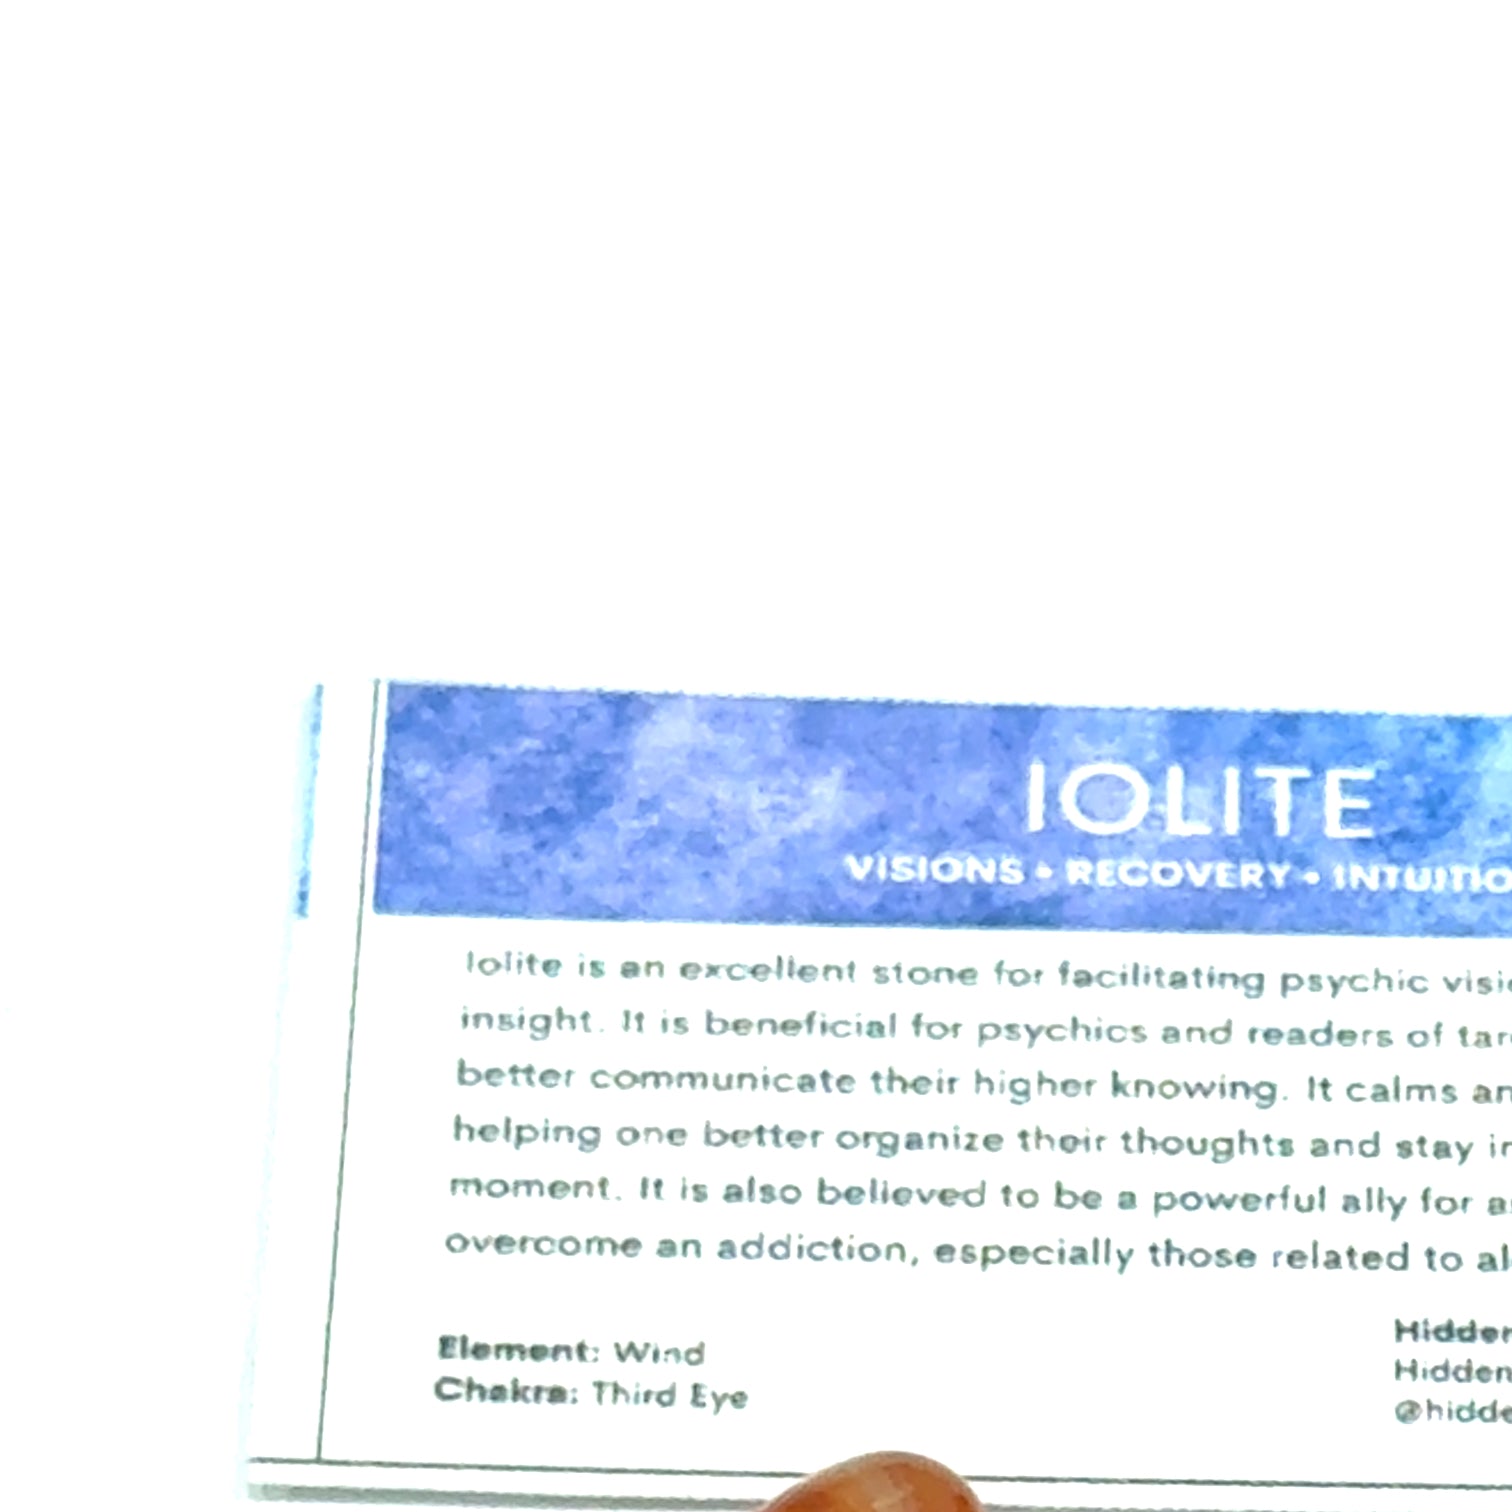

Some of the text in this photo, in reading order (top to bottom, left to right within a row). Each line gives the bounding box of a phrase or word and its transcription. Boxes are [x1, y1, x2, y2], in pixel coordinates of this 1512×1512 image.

[1027, 762, 1377, 839] IOLITE
[844, 853, 1025, 886] VISIONS
[1066, 857, 1290, 890] RECOVERY
[466, 950, 563, 978] Iolite
[578, 952, 606, 979] is
[619, 960, 665, 979] an
[679, 954, 856, 984] excellent
[872, 962, 979, 986] stone
[993, 959, 1044, 988] for
[1058, 959, 1265, 1000] facilitating
[1280, 967, 1429, 999] psychic
[622, 1009, 645, 1033] It
[660, 1009, 689, 1035] is
[705, 1009, 897, 1039] beneficial
[911, 1012, 963, 1041] for
[977, 1015, 1148, 1049] psychics
[1161, 1018, 1233, 1045] and
[1247, 1019, 1394, 1048] readers
[1406, 1021, 1444, 1049] of
[456, 1057, 575, 1089] better
[589, 1066, 856, 1094] communicate
[870, 1066, 960, 1096] their
[974, 1068, 1097, 1106] higher
[1111, 1069, 1288, 1110] knowing.
[1307, 1075, 1333, 1103] It
[1345, 1074, 1459, 1105] calms
[453, 1113, 602, 1154] helping
[616, 1126, 688, 1147] one
[703, 1120, 825, 1150] better
[835, 1125, 1004, 1159] organize
[1017, 1125, 1107, 1155] their
[1120, 1126, 1295, 1165] thoughts
[1309, 1130, 1381, 1159] and
[1395, 1135, 1474, 1166] stay
[450, 1176, 622, 1201] moment.
[639, 1176, 664, 1201] It
[680, 1177, 709, 1204] is
[722, 1175, 803, 1205] also
[816, 1176, 987, 1208] believed
[1000, 1184, 1040, 1210] to
[1054, 1180, 1103, 1211] be
[1117, 1190, 1138, 1211] a
[1153, 1184, 1327, 1218] powerful
[1341, 1186, 1408, 1222] ally
[1420, 1186, 1474, 1216] for
[444, 1232, 643, 1259] overcome
[655, 1238, 702, 1259] an
[716, 1232, 919, 1267] addiction,
[933, 1236, 1135, 1276] especially
[1148, 1237, 1258, 1269] those
[1272, 1239, 1410, 1272] related
[1423, 1246, 1464, 1273] to
[437, 1333, 706, 1367] Element: Wind
[433, 1375, 749, 1416] Chakra: Third Eye
